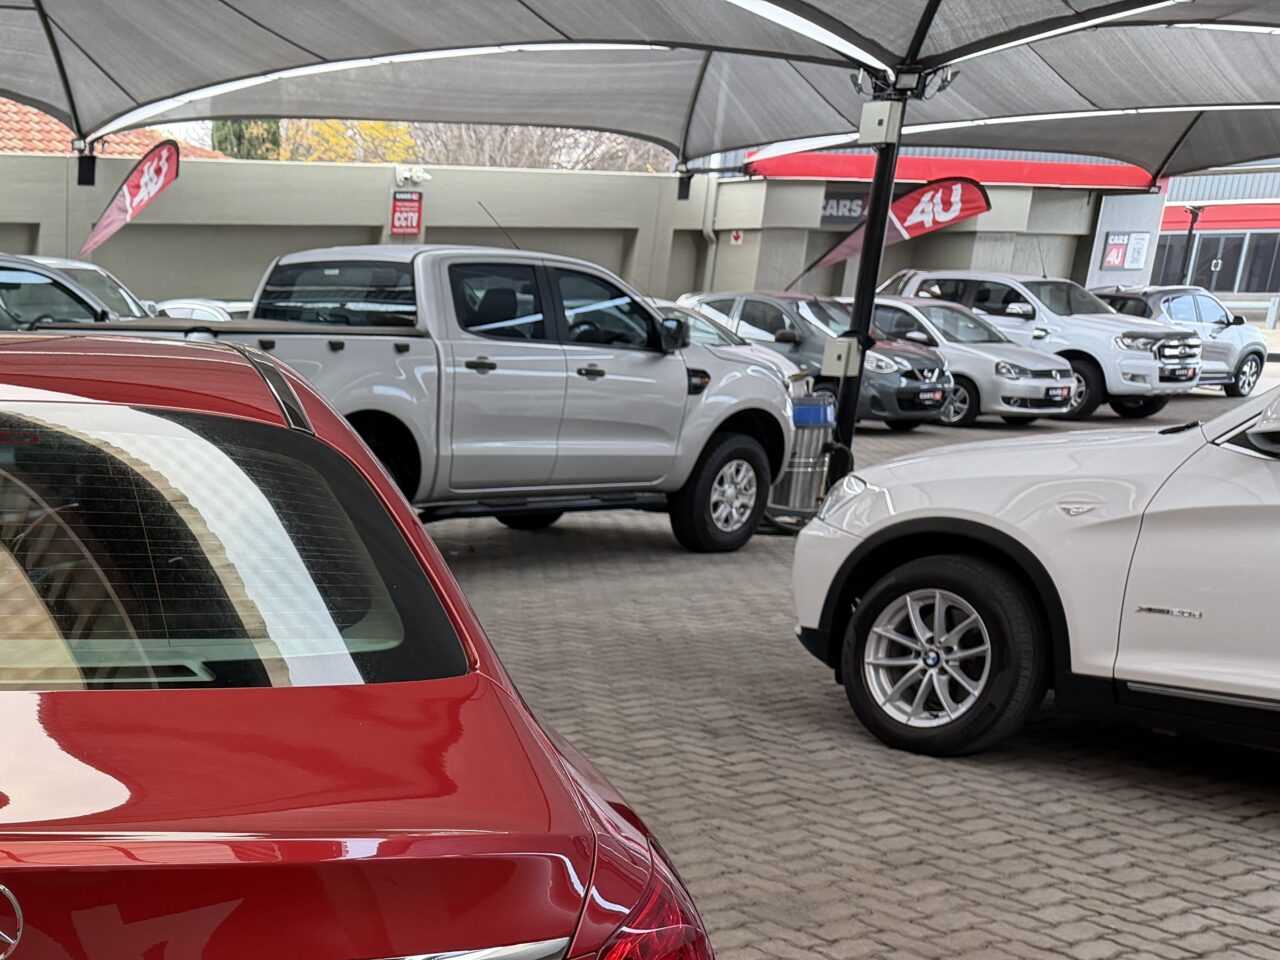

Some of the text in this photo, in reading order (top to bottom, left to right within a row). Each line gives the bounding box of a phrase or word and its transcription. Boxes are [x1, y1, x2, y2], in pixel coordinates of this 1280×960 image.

[903, 183, 962, 228] 4U
[394, 211, 419, 228] CCTV
[1109, 234, 1128, 244] CARS
[1106, 247, 1123, 265] 4U
